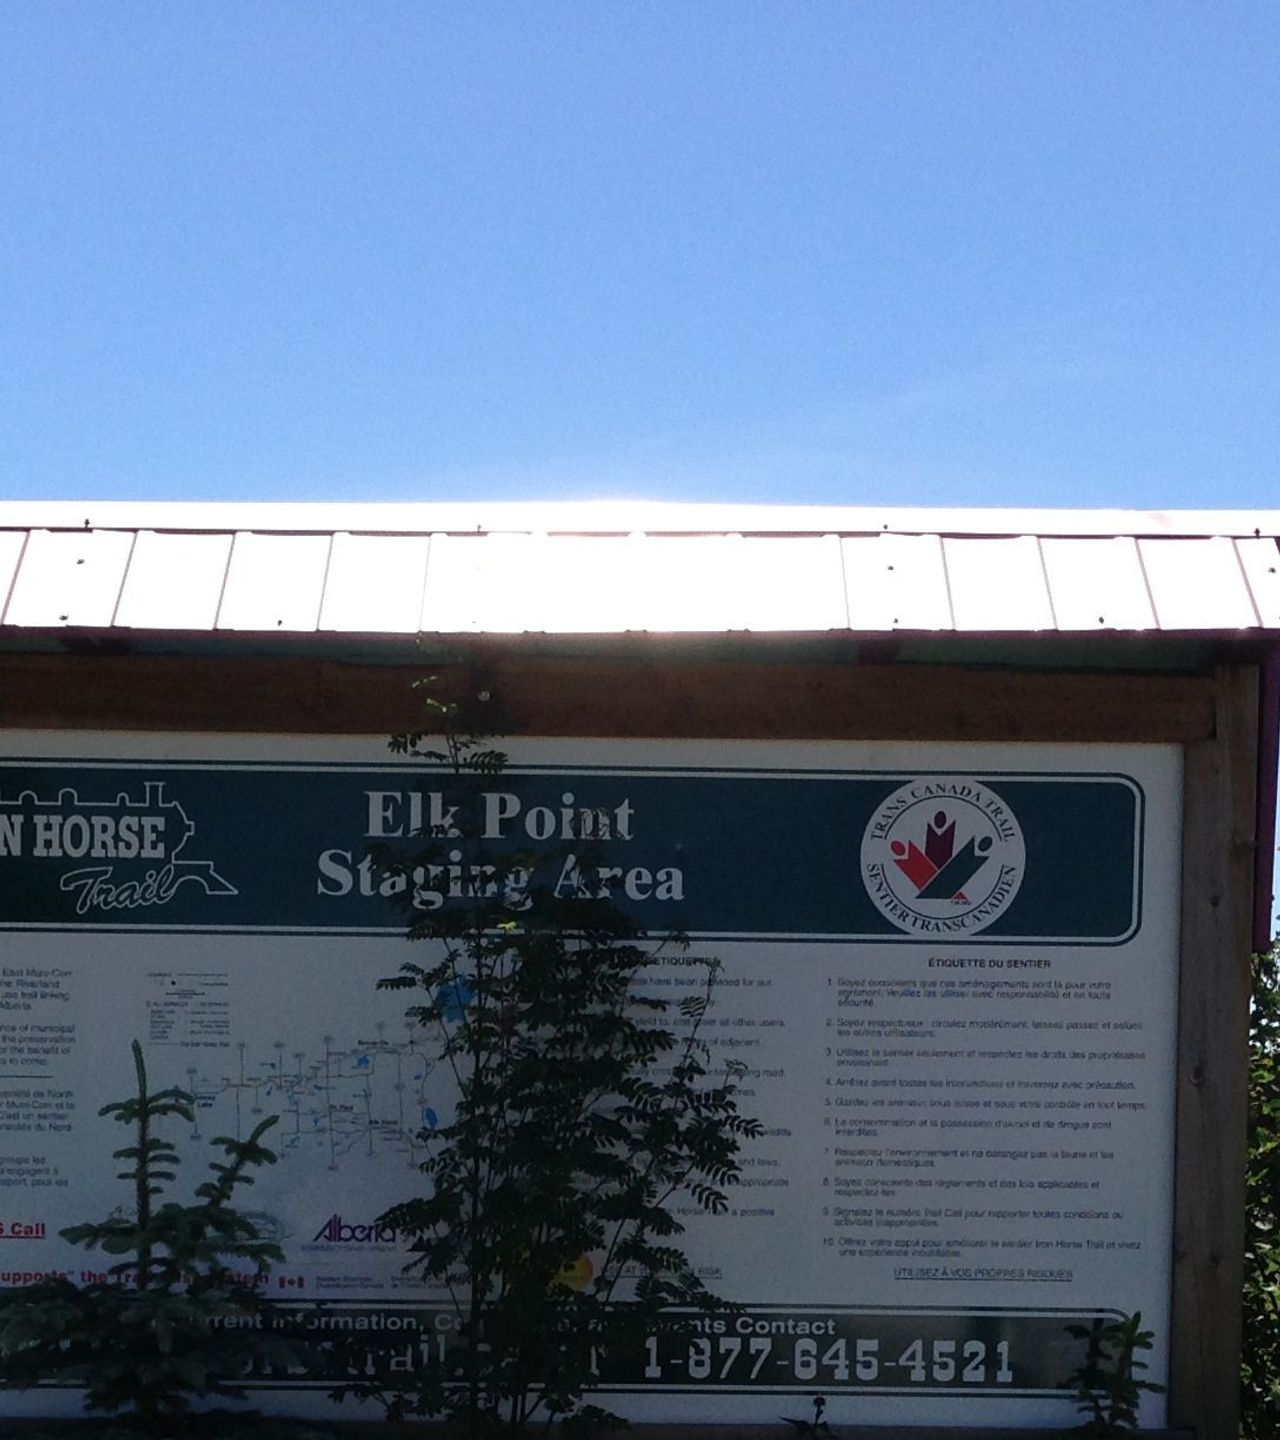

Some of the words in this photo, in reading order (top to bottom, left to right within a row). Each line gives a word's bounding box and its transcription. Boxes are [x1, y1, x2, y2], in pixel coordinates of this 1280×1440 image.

[362, 791, 463, 838] Elk
[482, 792, 634, 841] Point
[871, 799, 908, 840] TRANS
[910, 783, 981, 803] CANADA
[982, 798, 1017, 842] TRAIL
[33, 814, 165, 859] HORSE
[60, 863, 176, 914] Trail
[317, 849, 534, 910] Staging
[554, 854, 684, 901] Area
[867, 862, 911, 922] SENTIER
[909, 865, 1018, 932] TRANSCANADIEN
[988, 960, 1004, 968] DU
[1007, 960, 1052, 969] SENTIER
[11, 1222, 46, 1236] Call
[80, 1271, 108, 1283] the
[735, 1317, 835, 1335] Contact
[644, 1336, 1014, 1383] 1-877-645-4521
